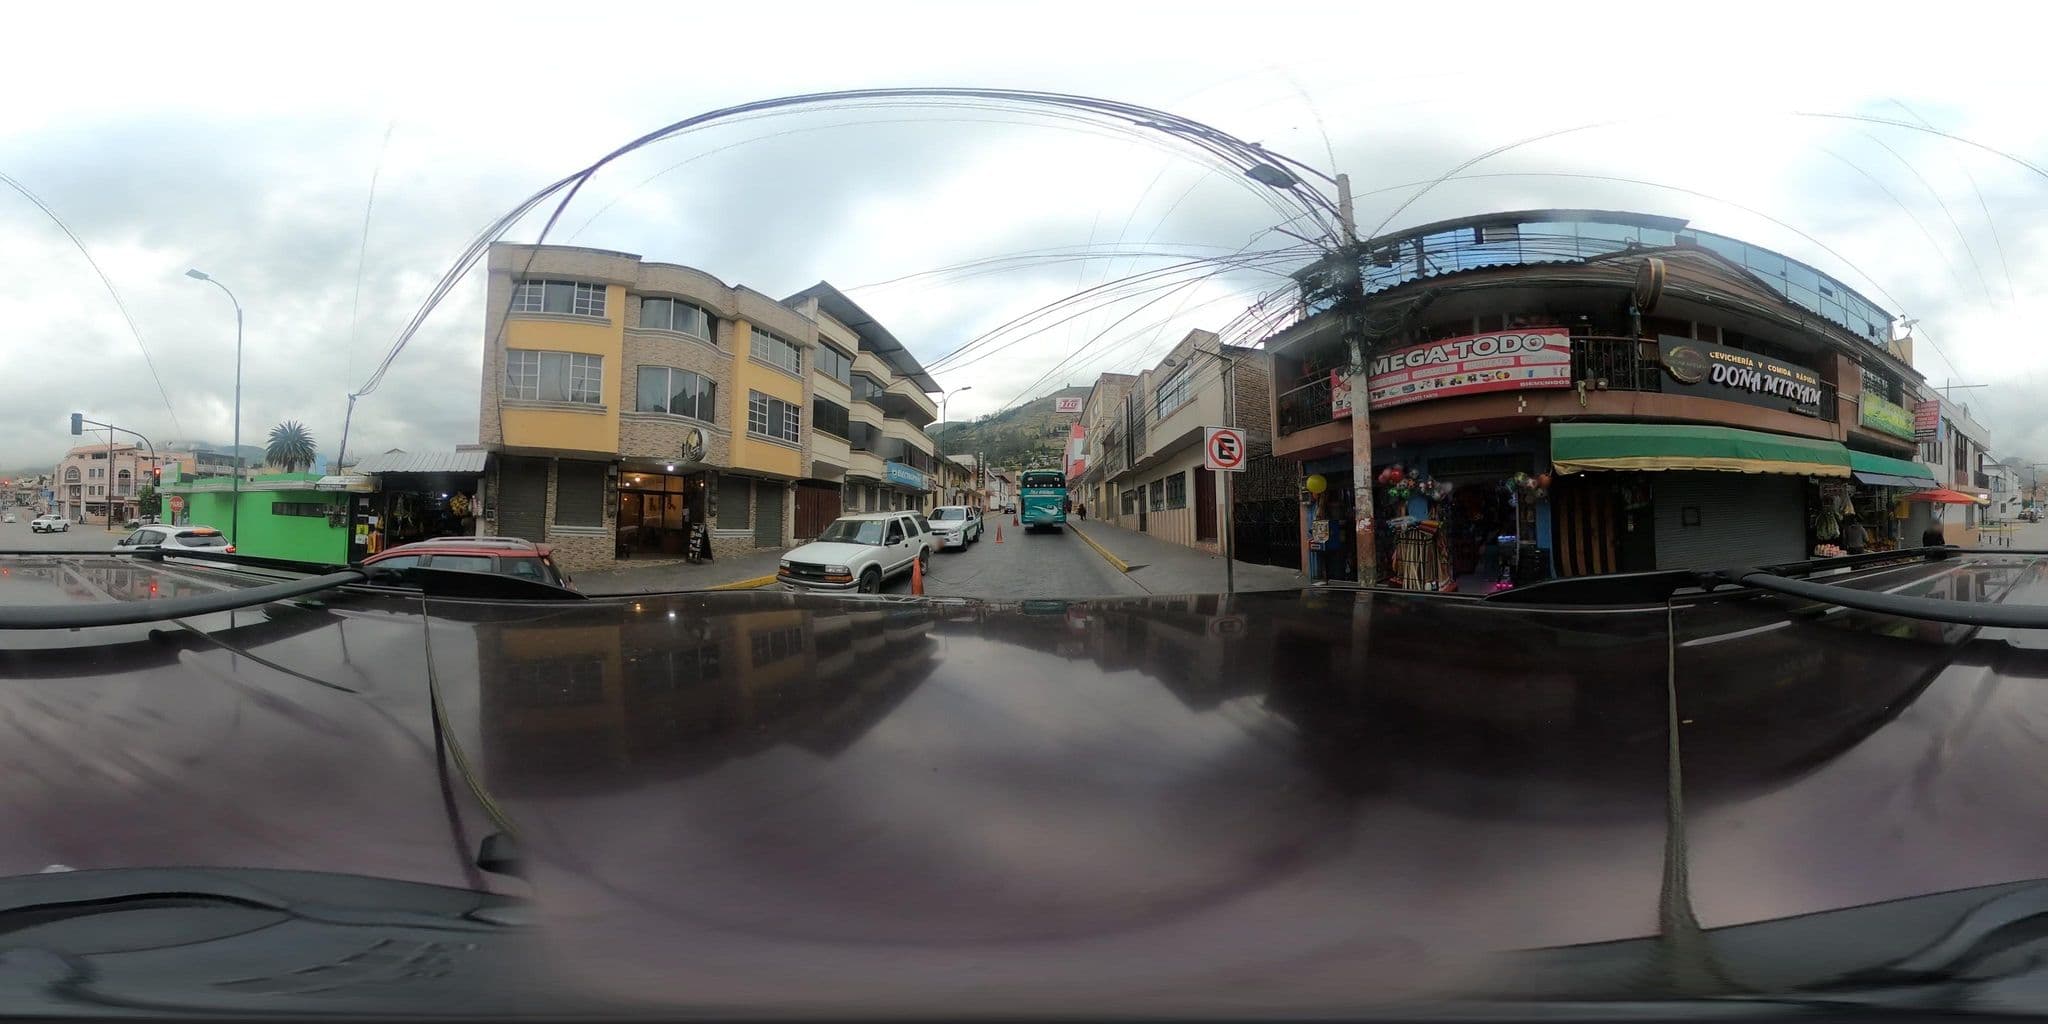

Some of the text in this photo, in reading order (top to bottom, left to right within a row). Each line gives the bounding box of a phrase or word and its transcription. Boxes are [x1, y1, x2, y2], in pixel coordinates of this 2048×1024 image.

[1369, 346, 1448, 377] MEGA
[1453, 334, 1546, 360] TODO
[1709, 351, 1754, 368] CEVICHERÍA
[1757, 361, 1764, 370] Y
[1767, 364, 1791, 378] COMIDA
[1520, 380, 1570, 388] BIENVENIDOS
[1711, 363, 1761, 393] DOÑA
[1764, 374, 1822, 405] MIRYAM
